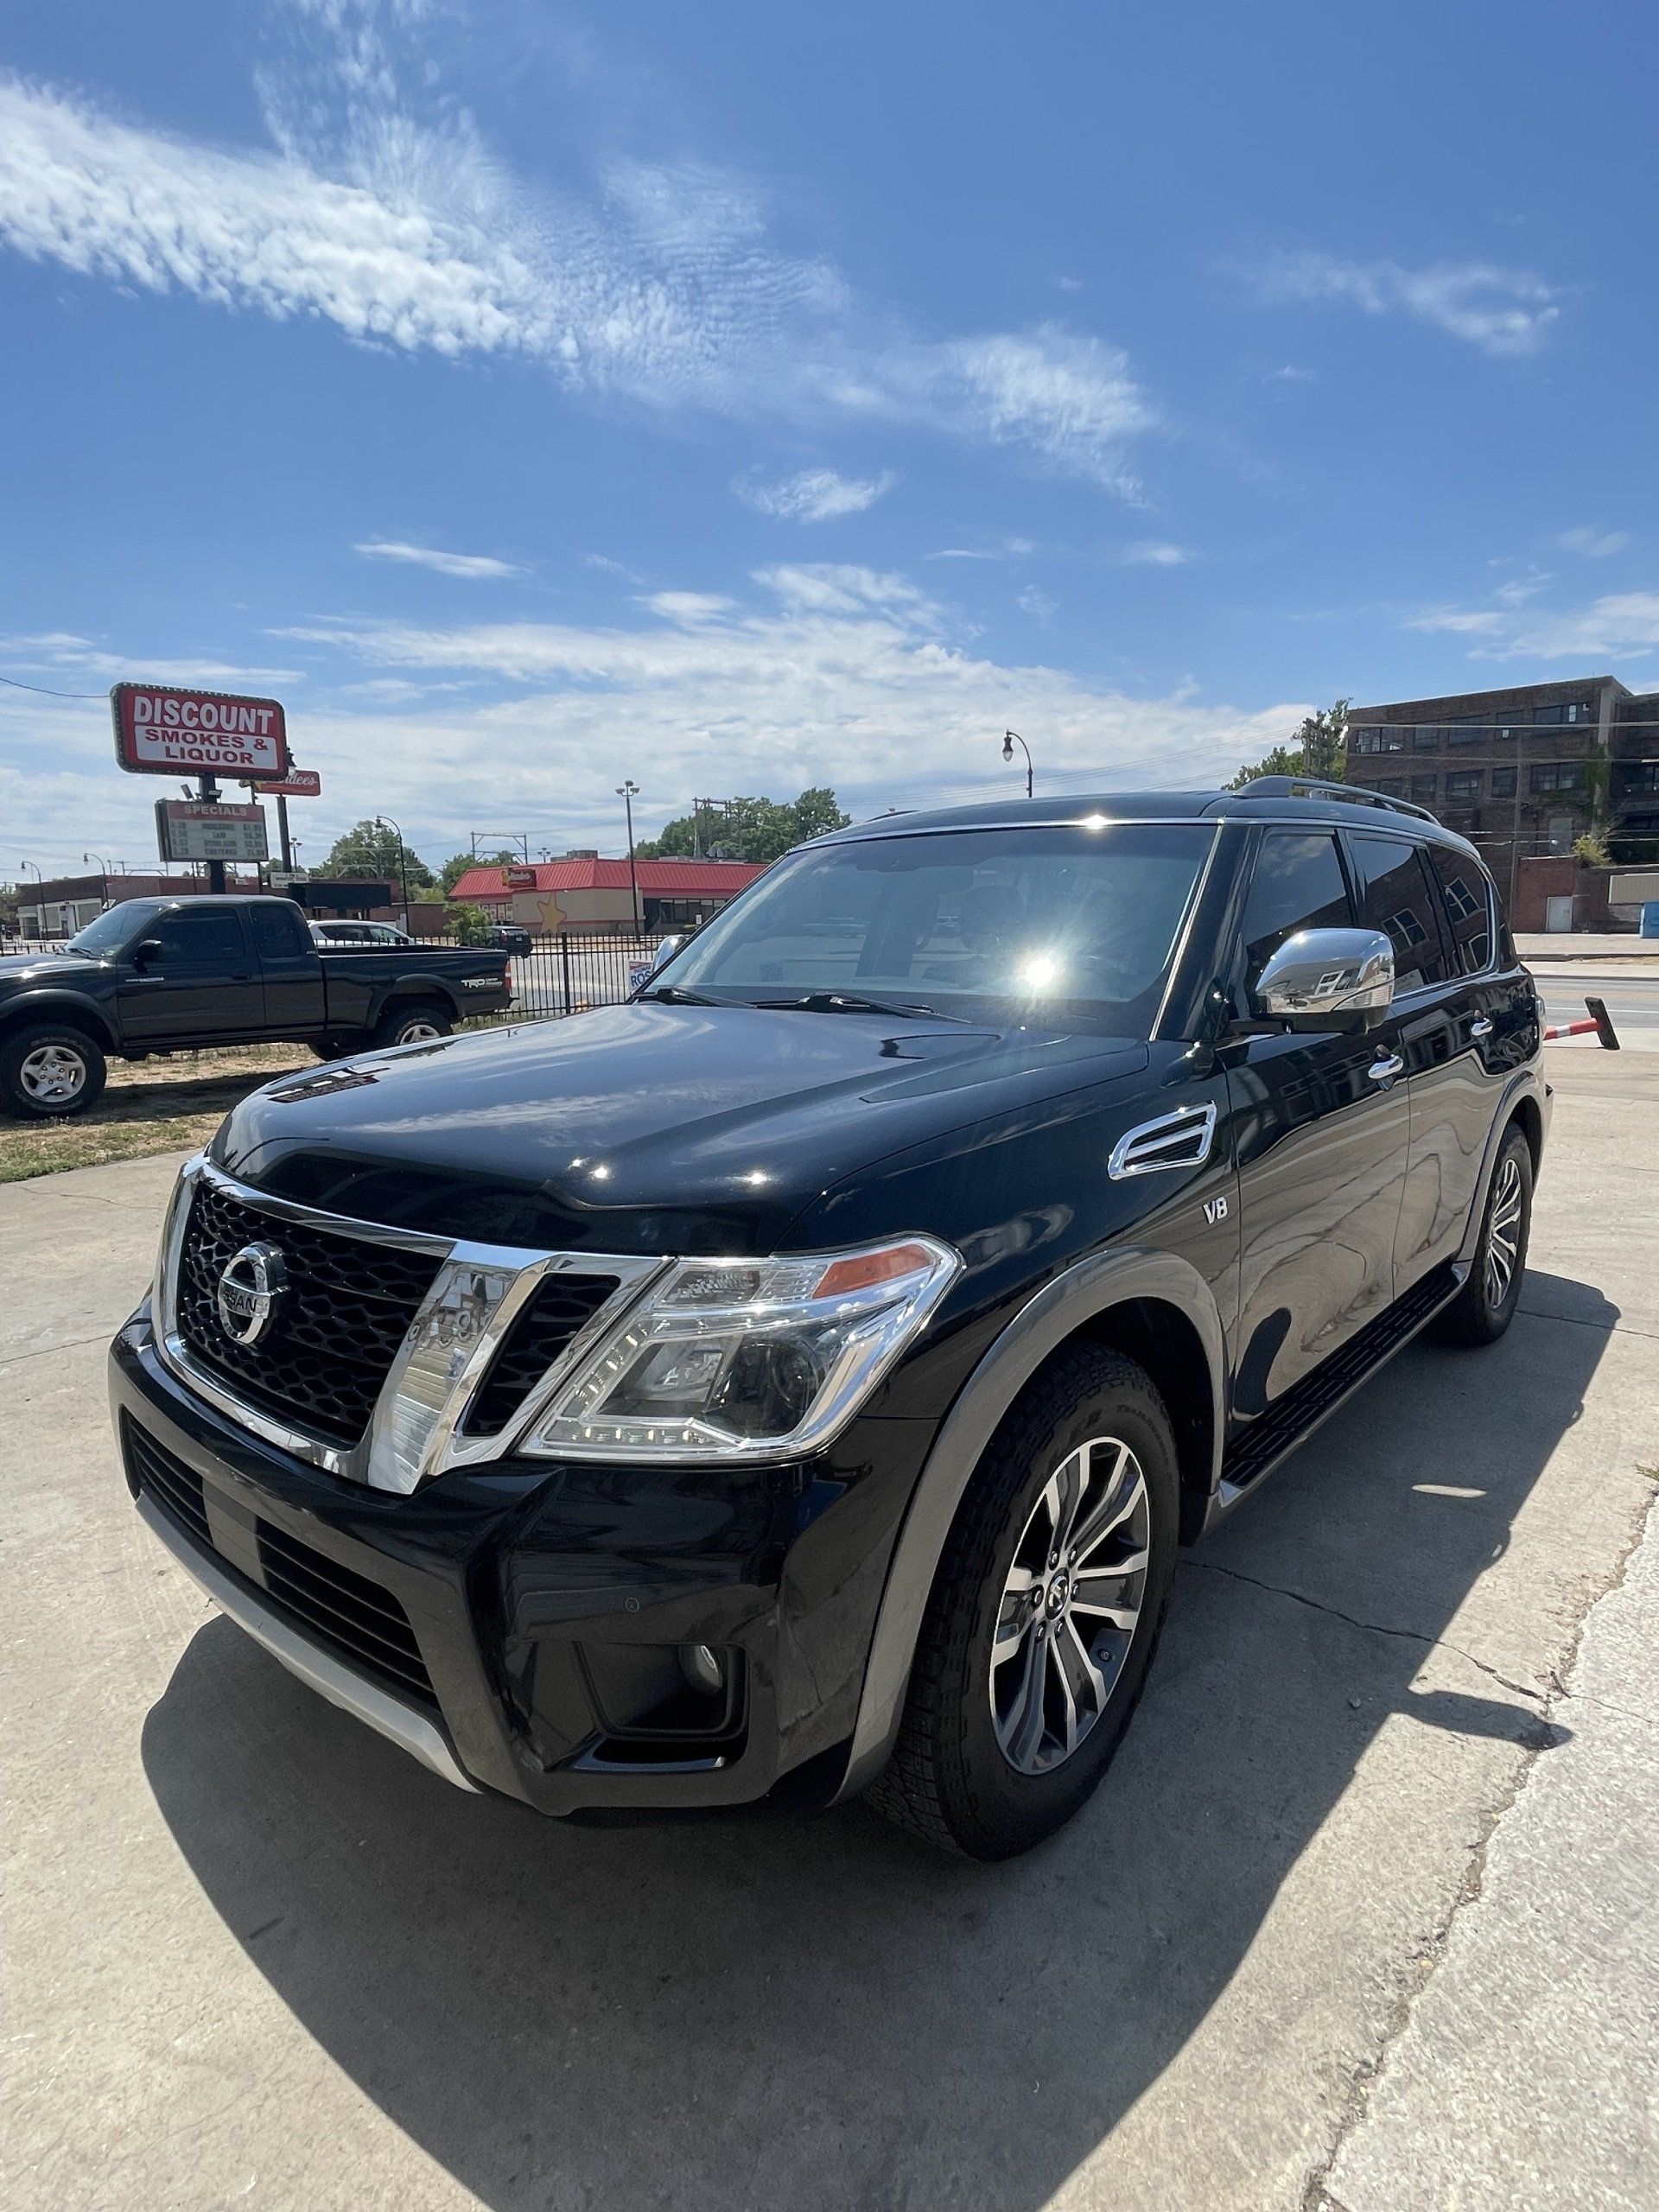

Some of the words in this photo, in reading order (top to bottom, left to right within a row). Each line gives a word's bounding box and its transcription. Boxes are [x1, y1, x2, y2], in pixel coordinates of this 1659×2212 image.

[134, 696, 274, 734] DISCOUNT
[144, 728, 245, 749] SMOKES
[253, 738, 270, 751] &
[164, 746, 255, 766] LIQUOR
[184, 805, 248, 817] SPECIALS
[461, 978, 486, 988] TRD
[1202, 1196, 1228, 1224] V8
